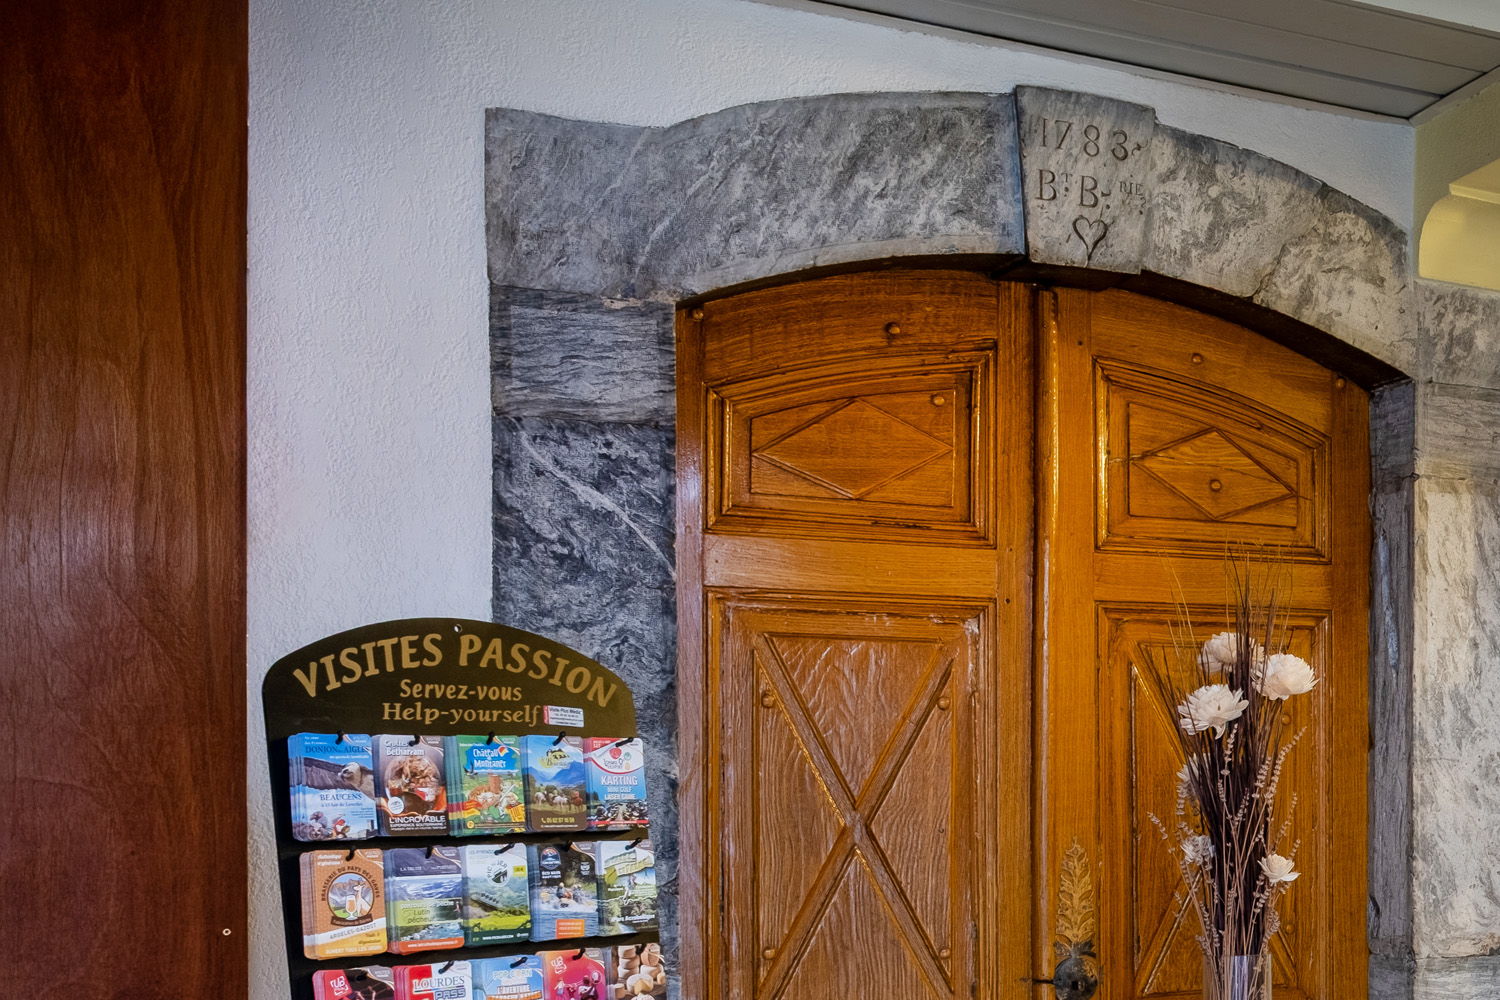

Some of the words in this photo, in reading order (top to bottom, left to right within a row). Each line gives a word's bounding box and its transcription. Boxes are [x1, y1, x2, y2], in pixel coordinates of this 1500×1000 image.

[1040, 117, 1129, 162] 1783
[292, 633, 443, 698] VISITES
[458, 633, 618, 708] PASSION
[399, 678, 523, 702] Servez-vous
[382, 701, 542, 728] Help-yourself
[601, 776, 638, 786] KARTING
[414, 976, 465, 990] LOURDES
[434, 988, 466, 1000] PASS
